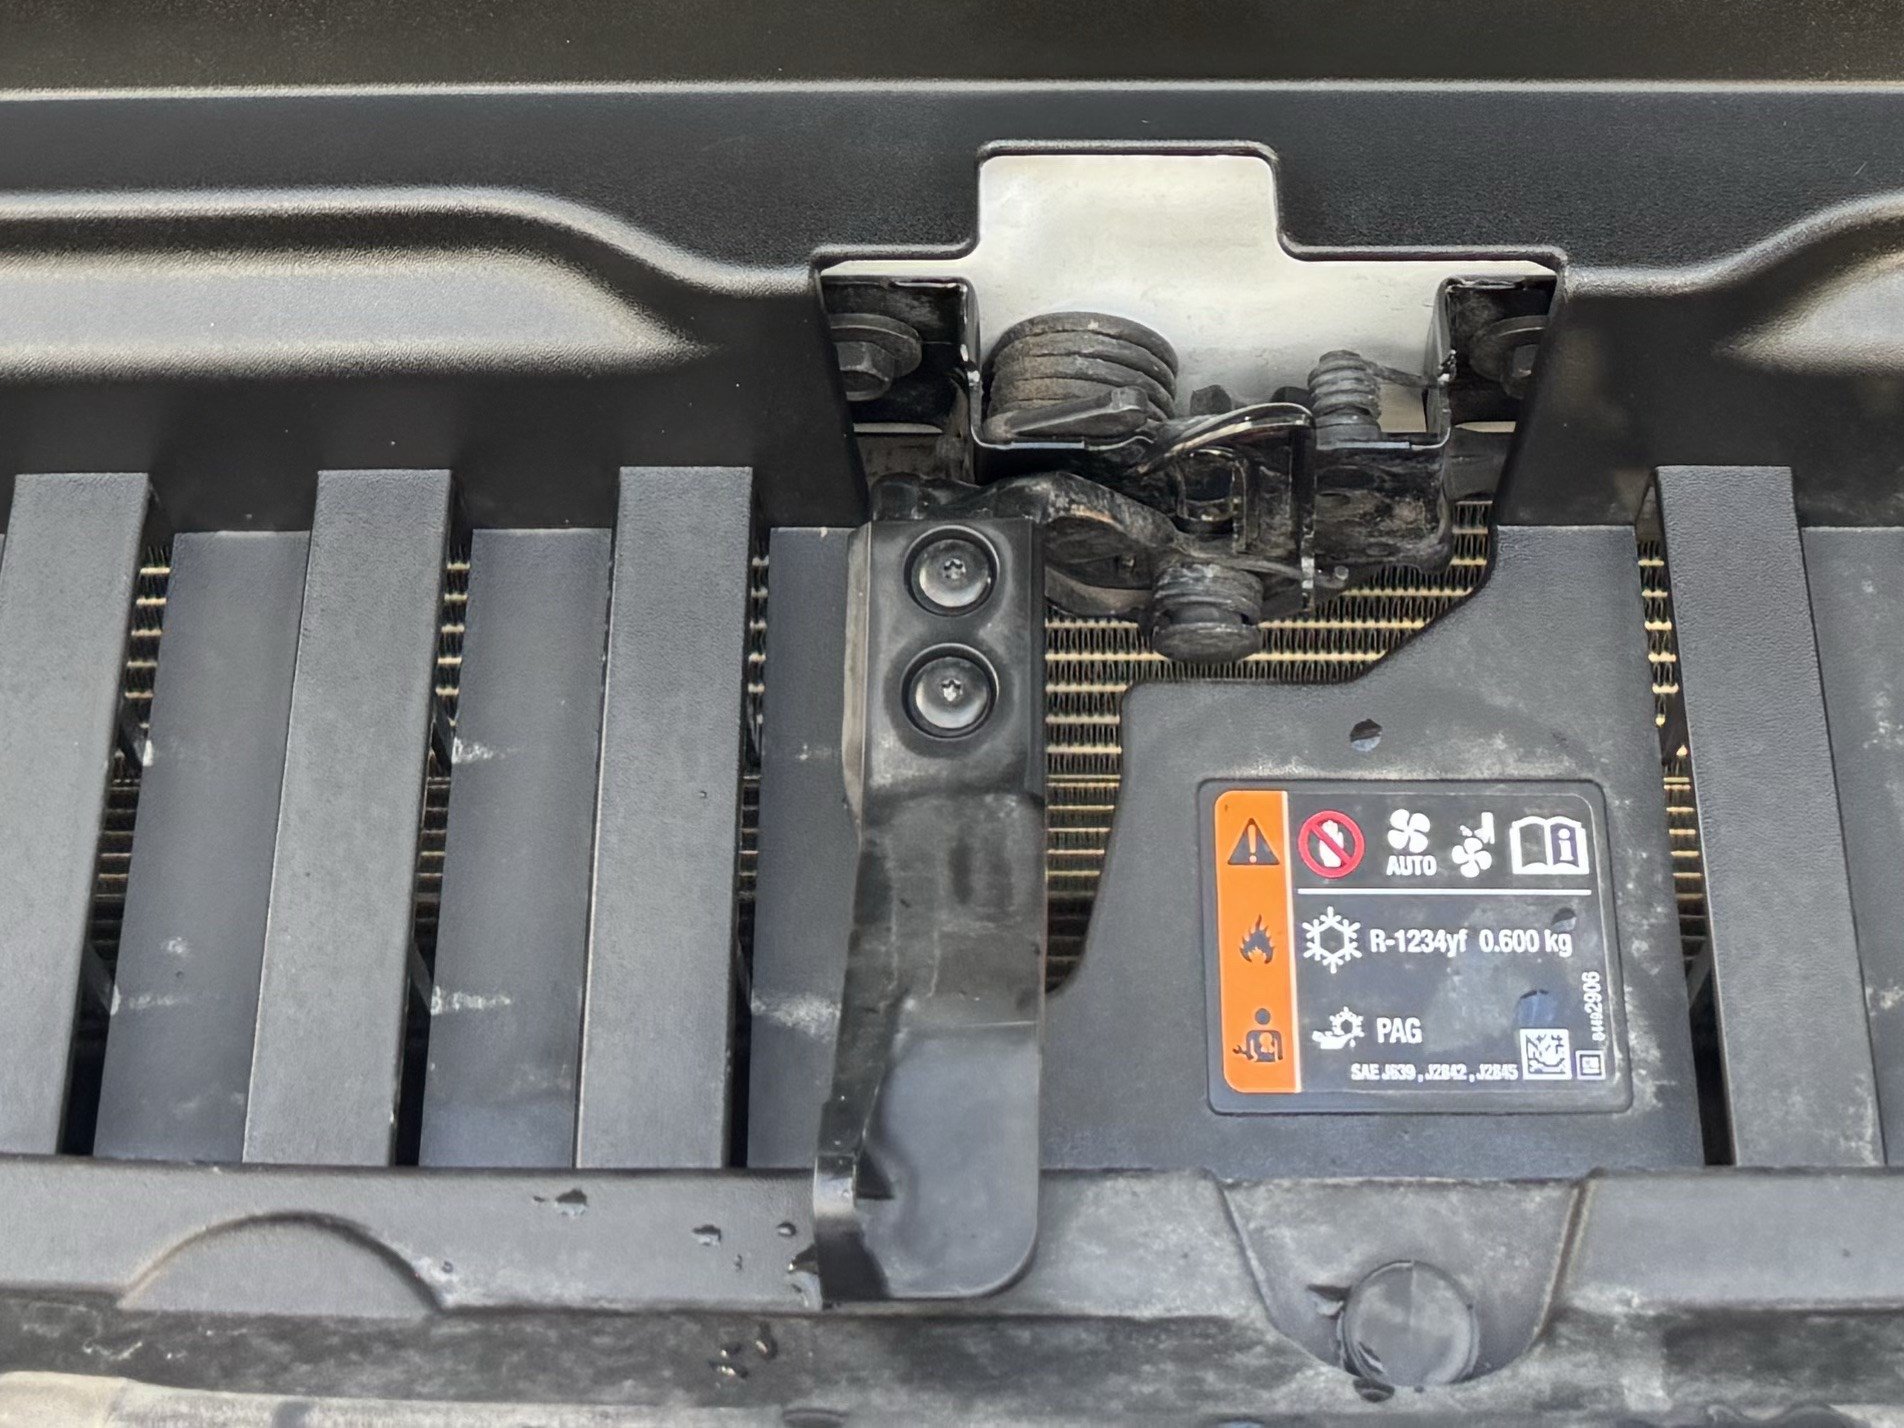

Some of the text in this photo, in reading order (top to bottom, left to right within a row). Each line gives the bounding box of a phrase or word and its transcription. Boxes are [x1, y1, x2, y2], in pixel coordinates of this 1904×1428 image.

[1386, 855, 1438, 876] AUTO
[1370, 929, 1573, 958] R-1234yf 0.600 kg
[1376, 1017, 1423, 1044] PAG
[1350, 1063, 1380, 1081] SAE
